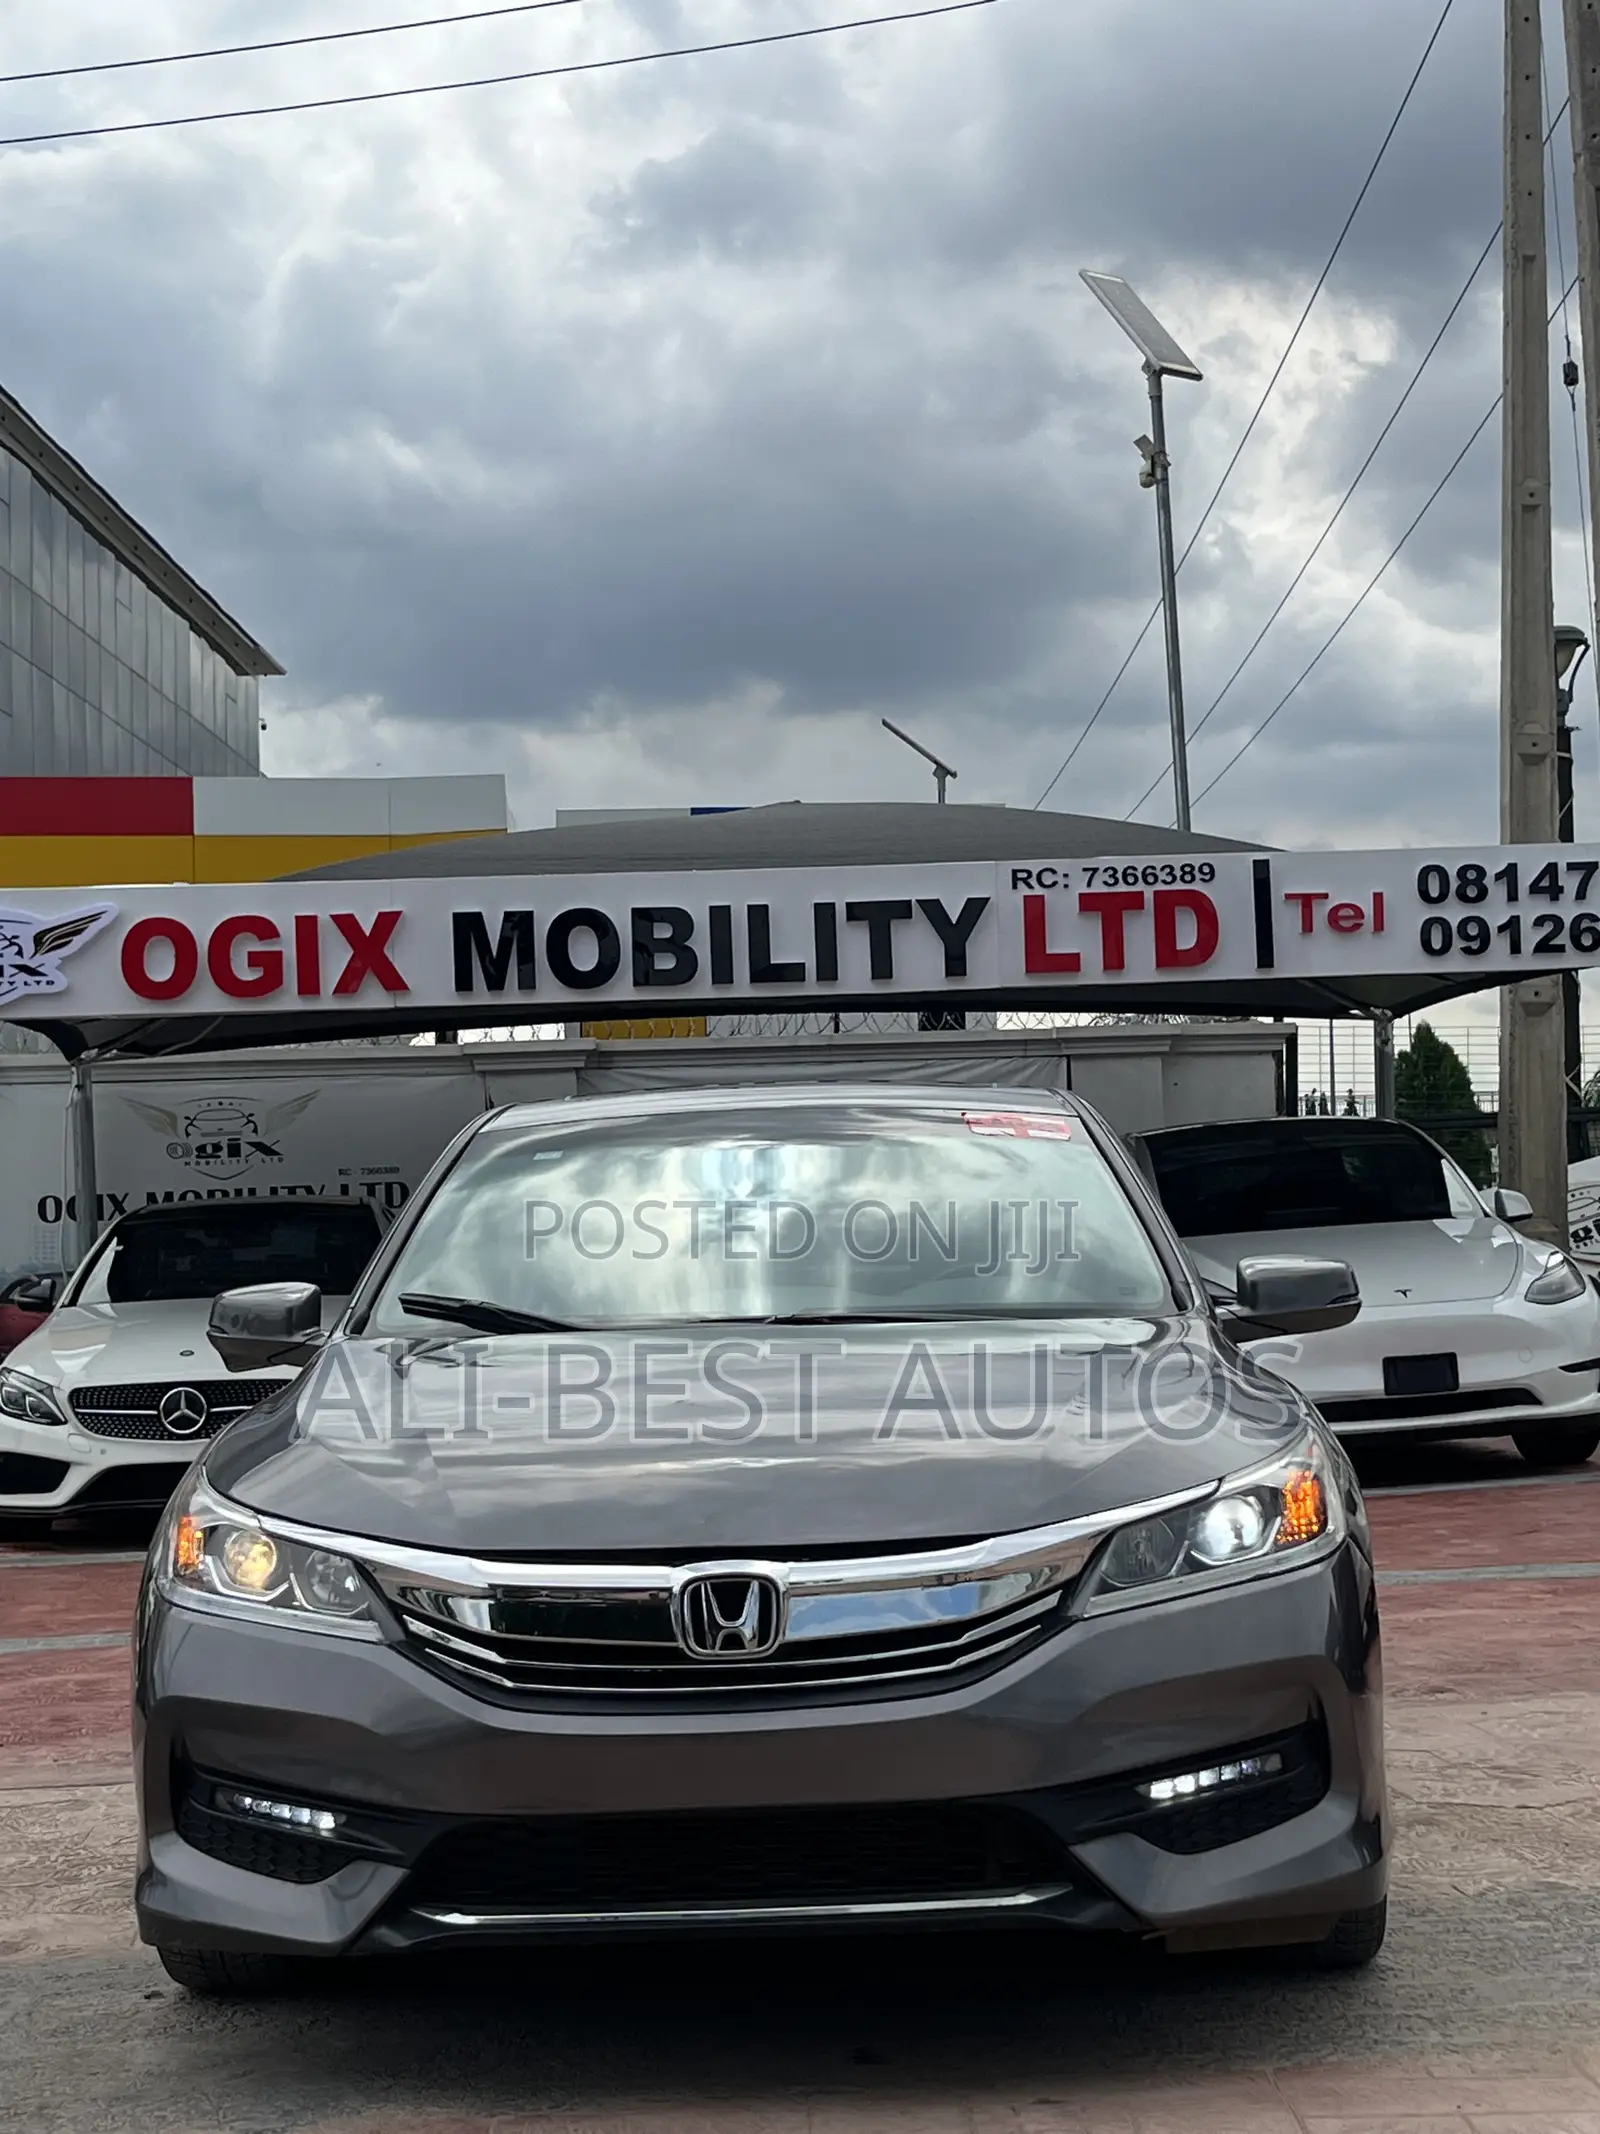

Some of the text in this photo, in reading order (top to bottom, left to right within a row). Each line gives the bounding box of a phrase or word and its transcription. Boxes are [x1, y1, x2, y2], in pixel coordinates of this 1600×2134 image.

[1010, 862, 1216, 890] RC: 7366389
[1416, 860, 1600, 904] 08147
[120, 888, 1385, 1000] OGIX MOBILITY LTD Tel
[1419, 913, 1600, 957] 09126
